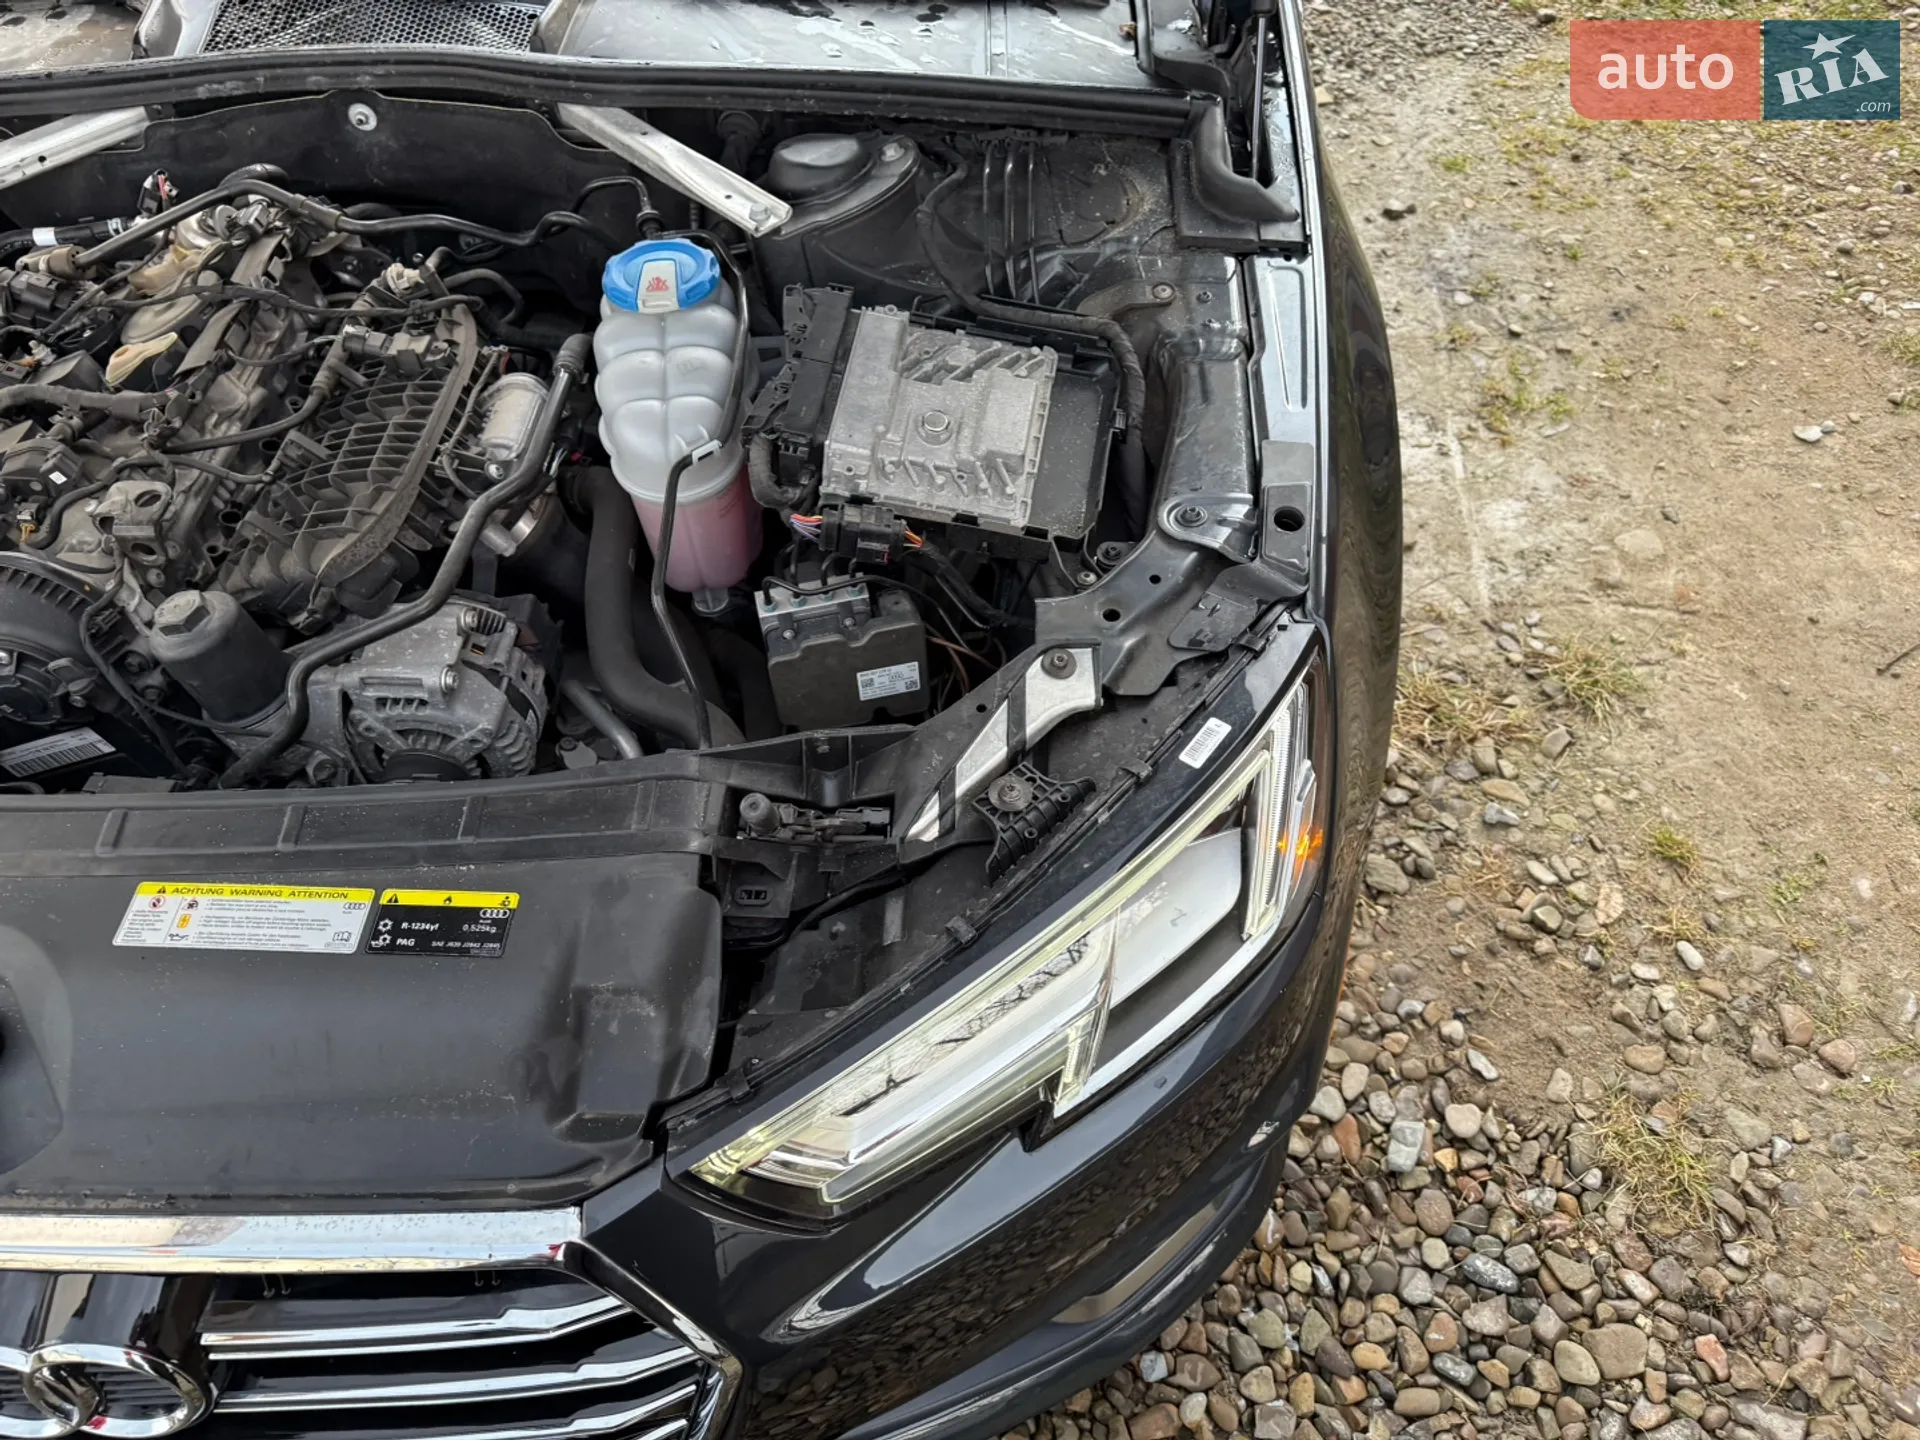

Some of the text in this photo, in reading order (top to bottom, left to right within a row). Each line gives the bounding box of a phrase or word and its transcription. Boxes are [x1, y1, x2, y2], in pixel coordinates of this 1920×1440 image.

[171, 887, 349, 899] ACHTUNG WARNING ATTENTION
[401, 921, 440, 932] R-1234yf
[396, 938, 416, 947] PAG
